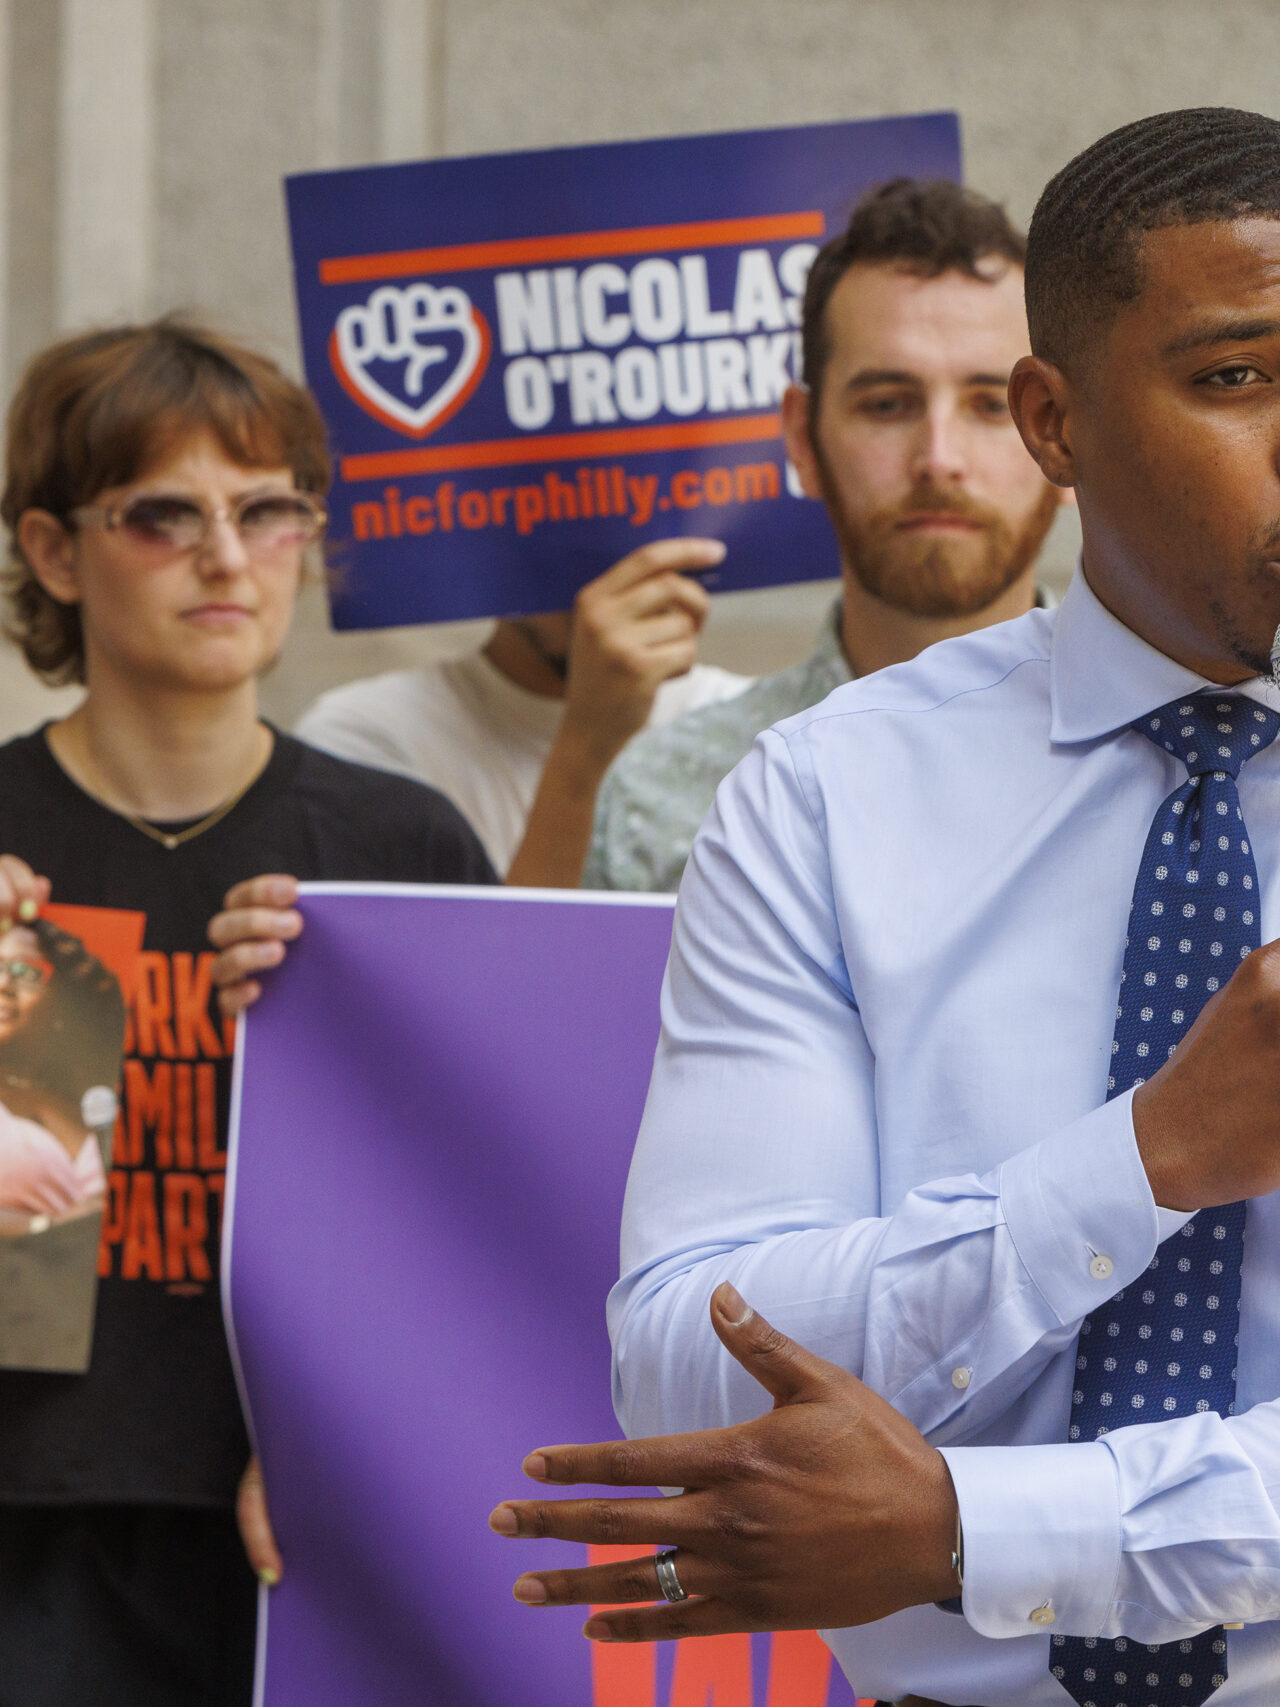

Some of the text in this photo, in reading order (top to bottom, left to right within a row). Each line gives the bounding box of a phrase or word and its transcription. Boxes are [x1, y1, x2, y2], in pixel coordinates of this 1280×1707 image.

[495, 243, 819, 354] NICOLAS
[504, 329, 804, 432] O'ROURK
[352, 461, 780, 540] nicforphilly.com
[123, 951, 234, 1057] RK
